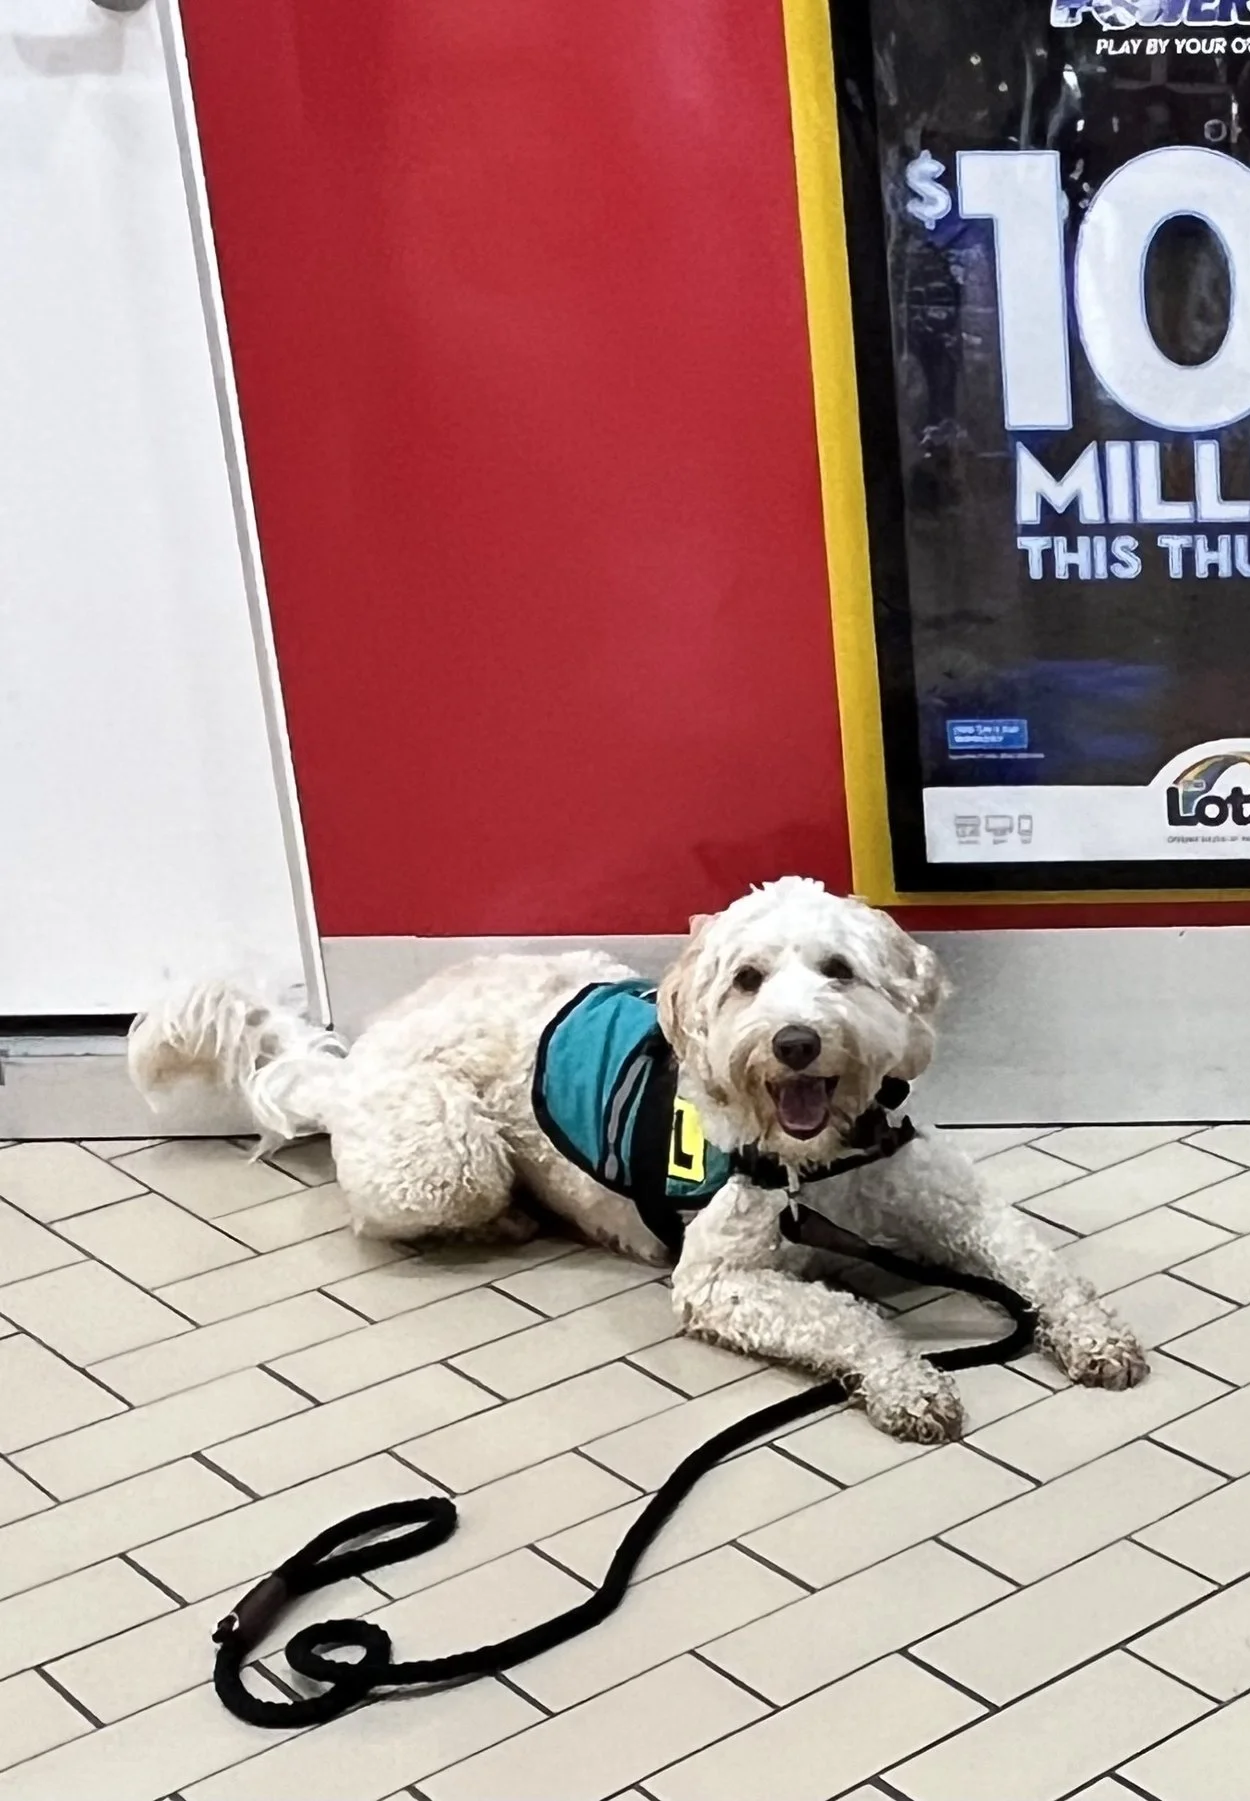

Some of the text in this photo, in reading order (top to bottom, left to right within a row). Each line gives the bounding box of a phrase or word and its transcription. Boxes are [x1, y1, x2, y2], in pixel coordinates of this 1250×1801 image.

[1095, 38, 1143, 56] PLAY
[1145, 38, 1171, 55] BY
[1174, 37, 1228, 55] YOUR
[1017, 535, 1143, 581] THIS
[673, 1108, 694, 1170] L
